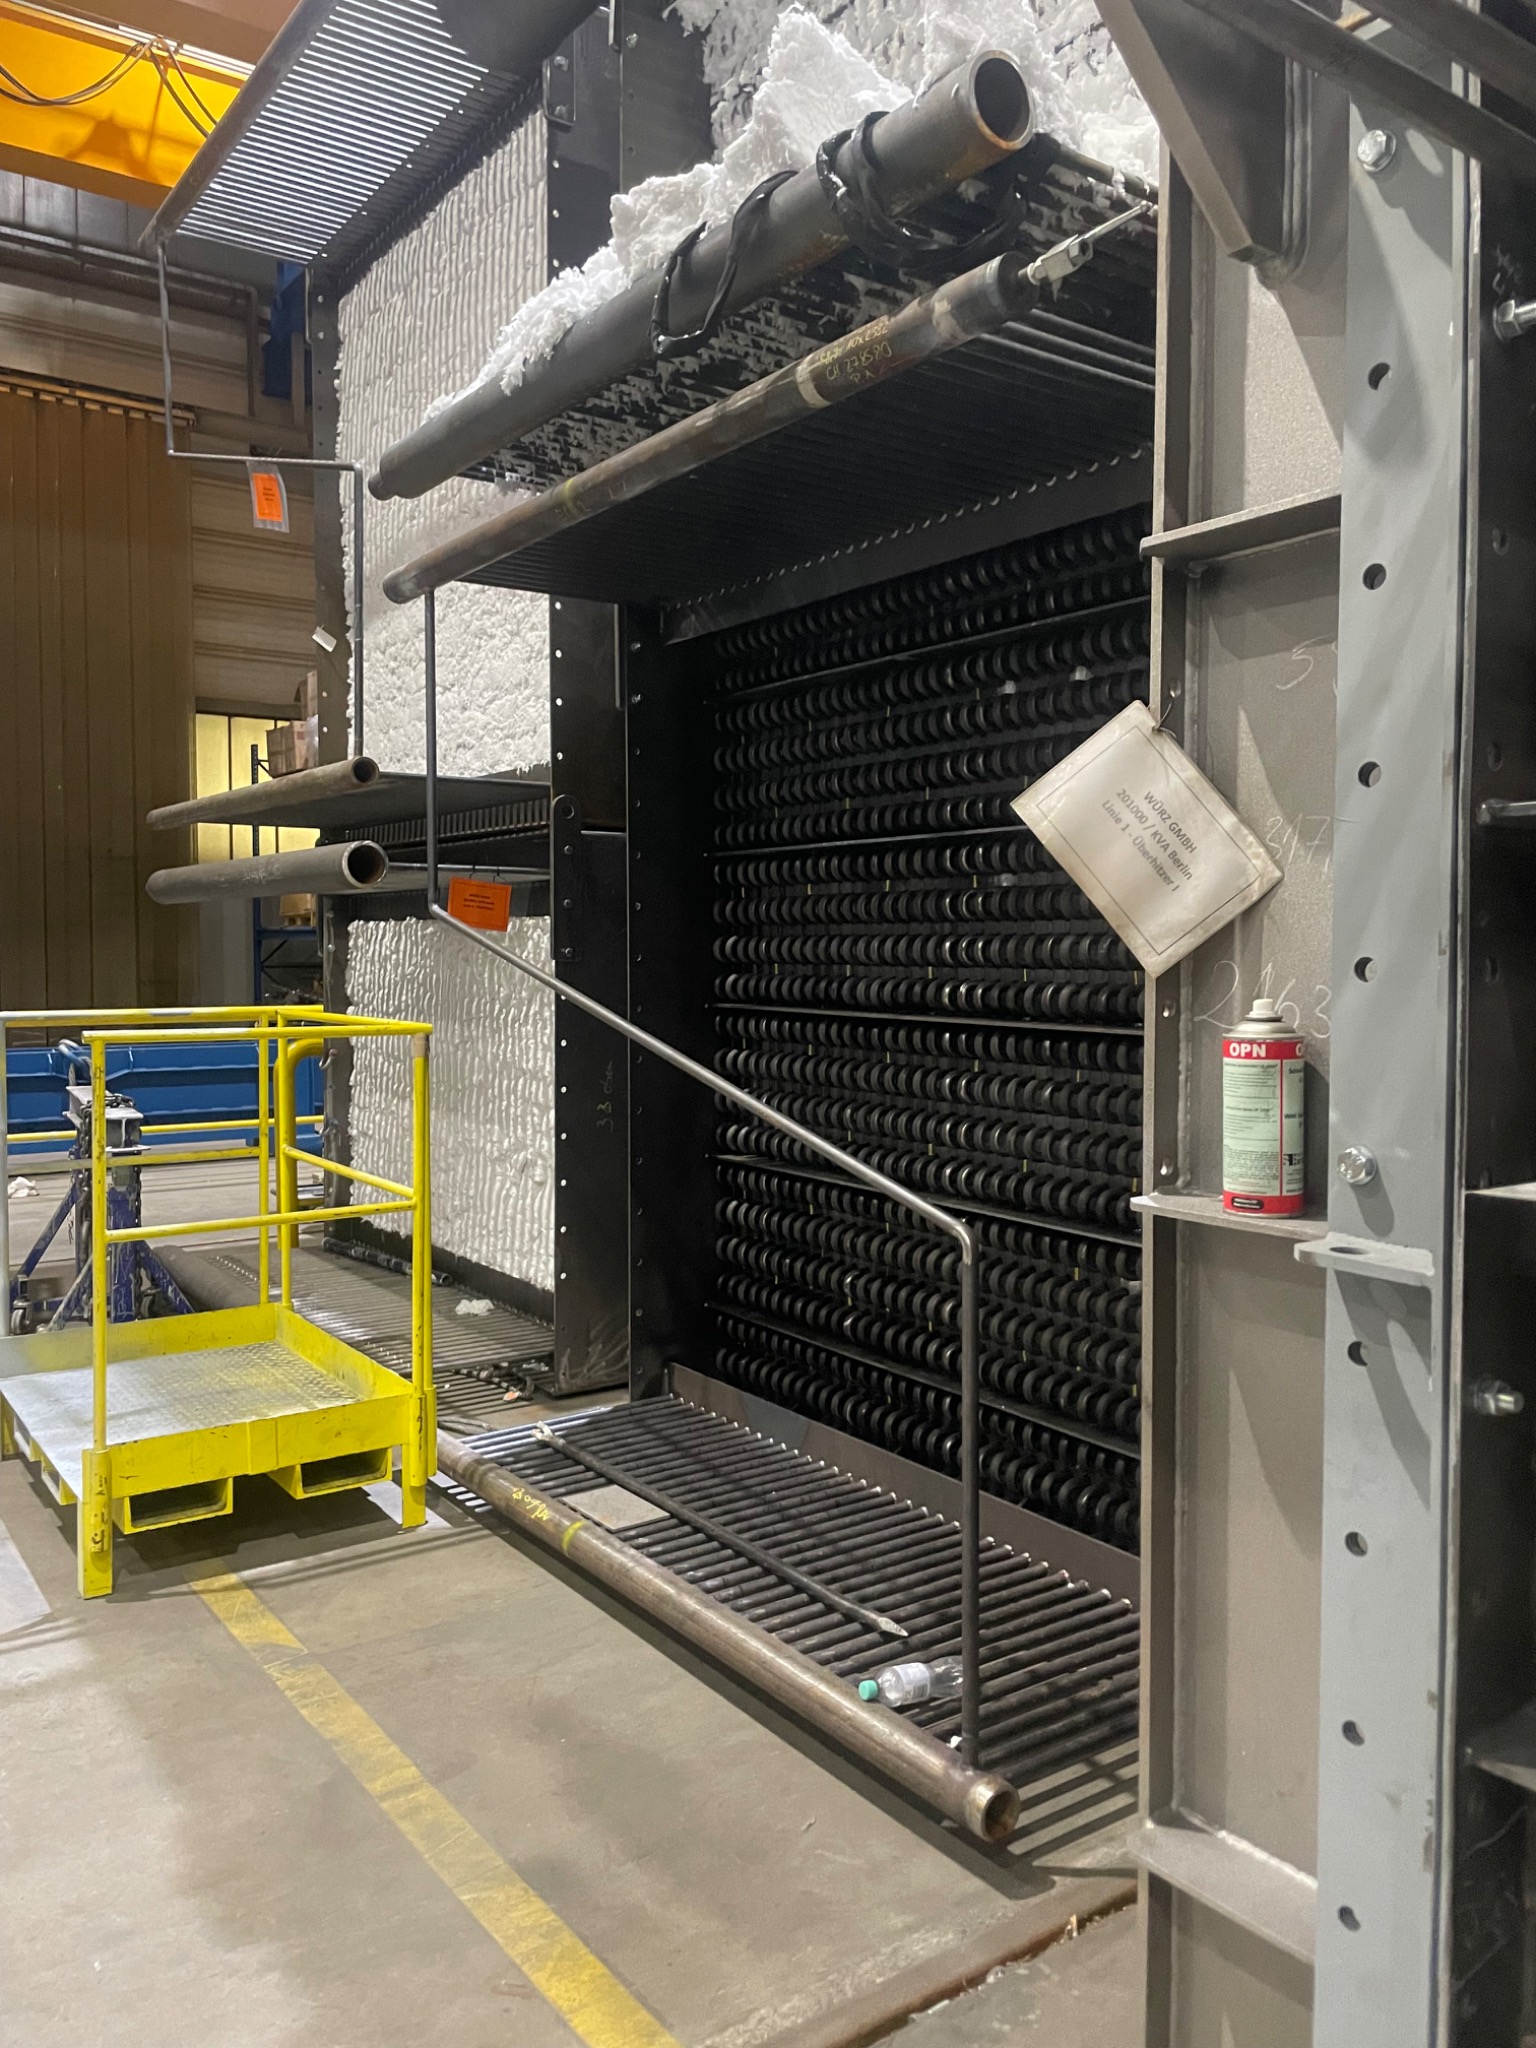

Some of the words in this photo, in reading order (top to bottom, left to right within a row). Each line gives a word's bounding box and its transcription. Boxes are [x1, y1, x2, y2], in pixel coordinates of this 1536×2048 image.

[1101, 799, 1123, 825] Linie
[1120, 823, 1131, 833] 1
[1131, 835, 1175, 886] Überhitzer
[1115, 788, 1149, 825] 201000
[1150, 829, 1171, 854] KVA
[1168, 850, 1193, 881] Berlin
[1143, 791, 1172, 824] WÜRZ
[1168, 821, 1198, 854] GMBH
[1229, 1042, 1267, 1058] OPN
